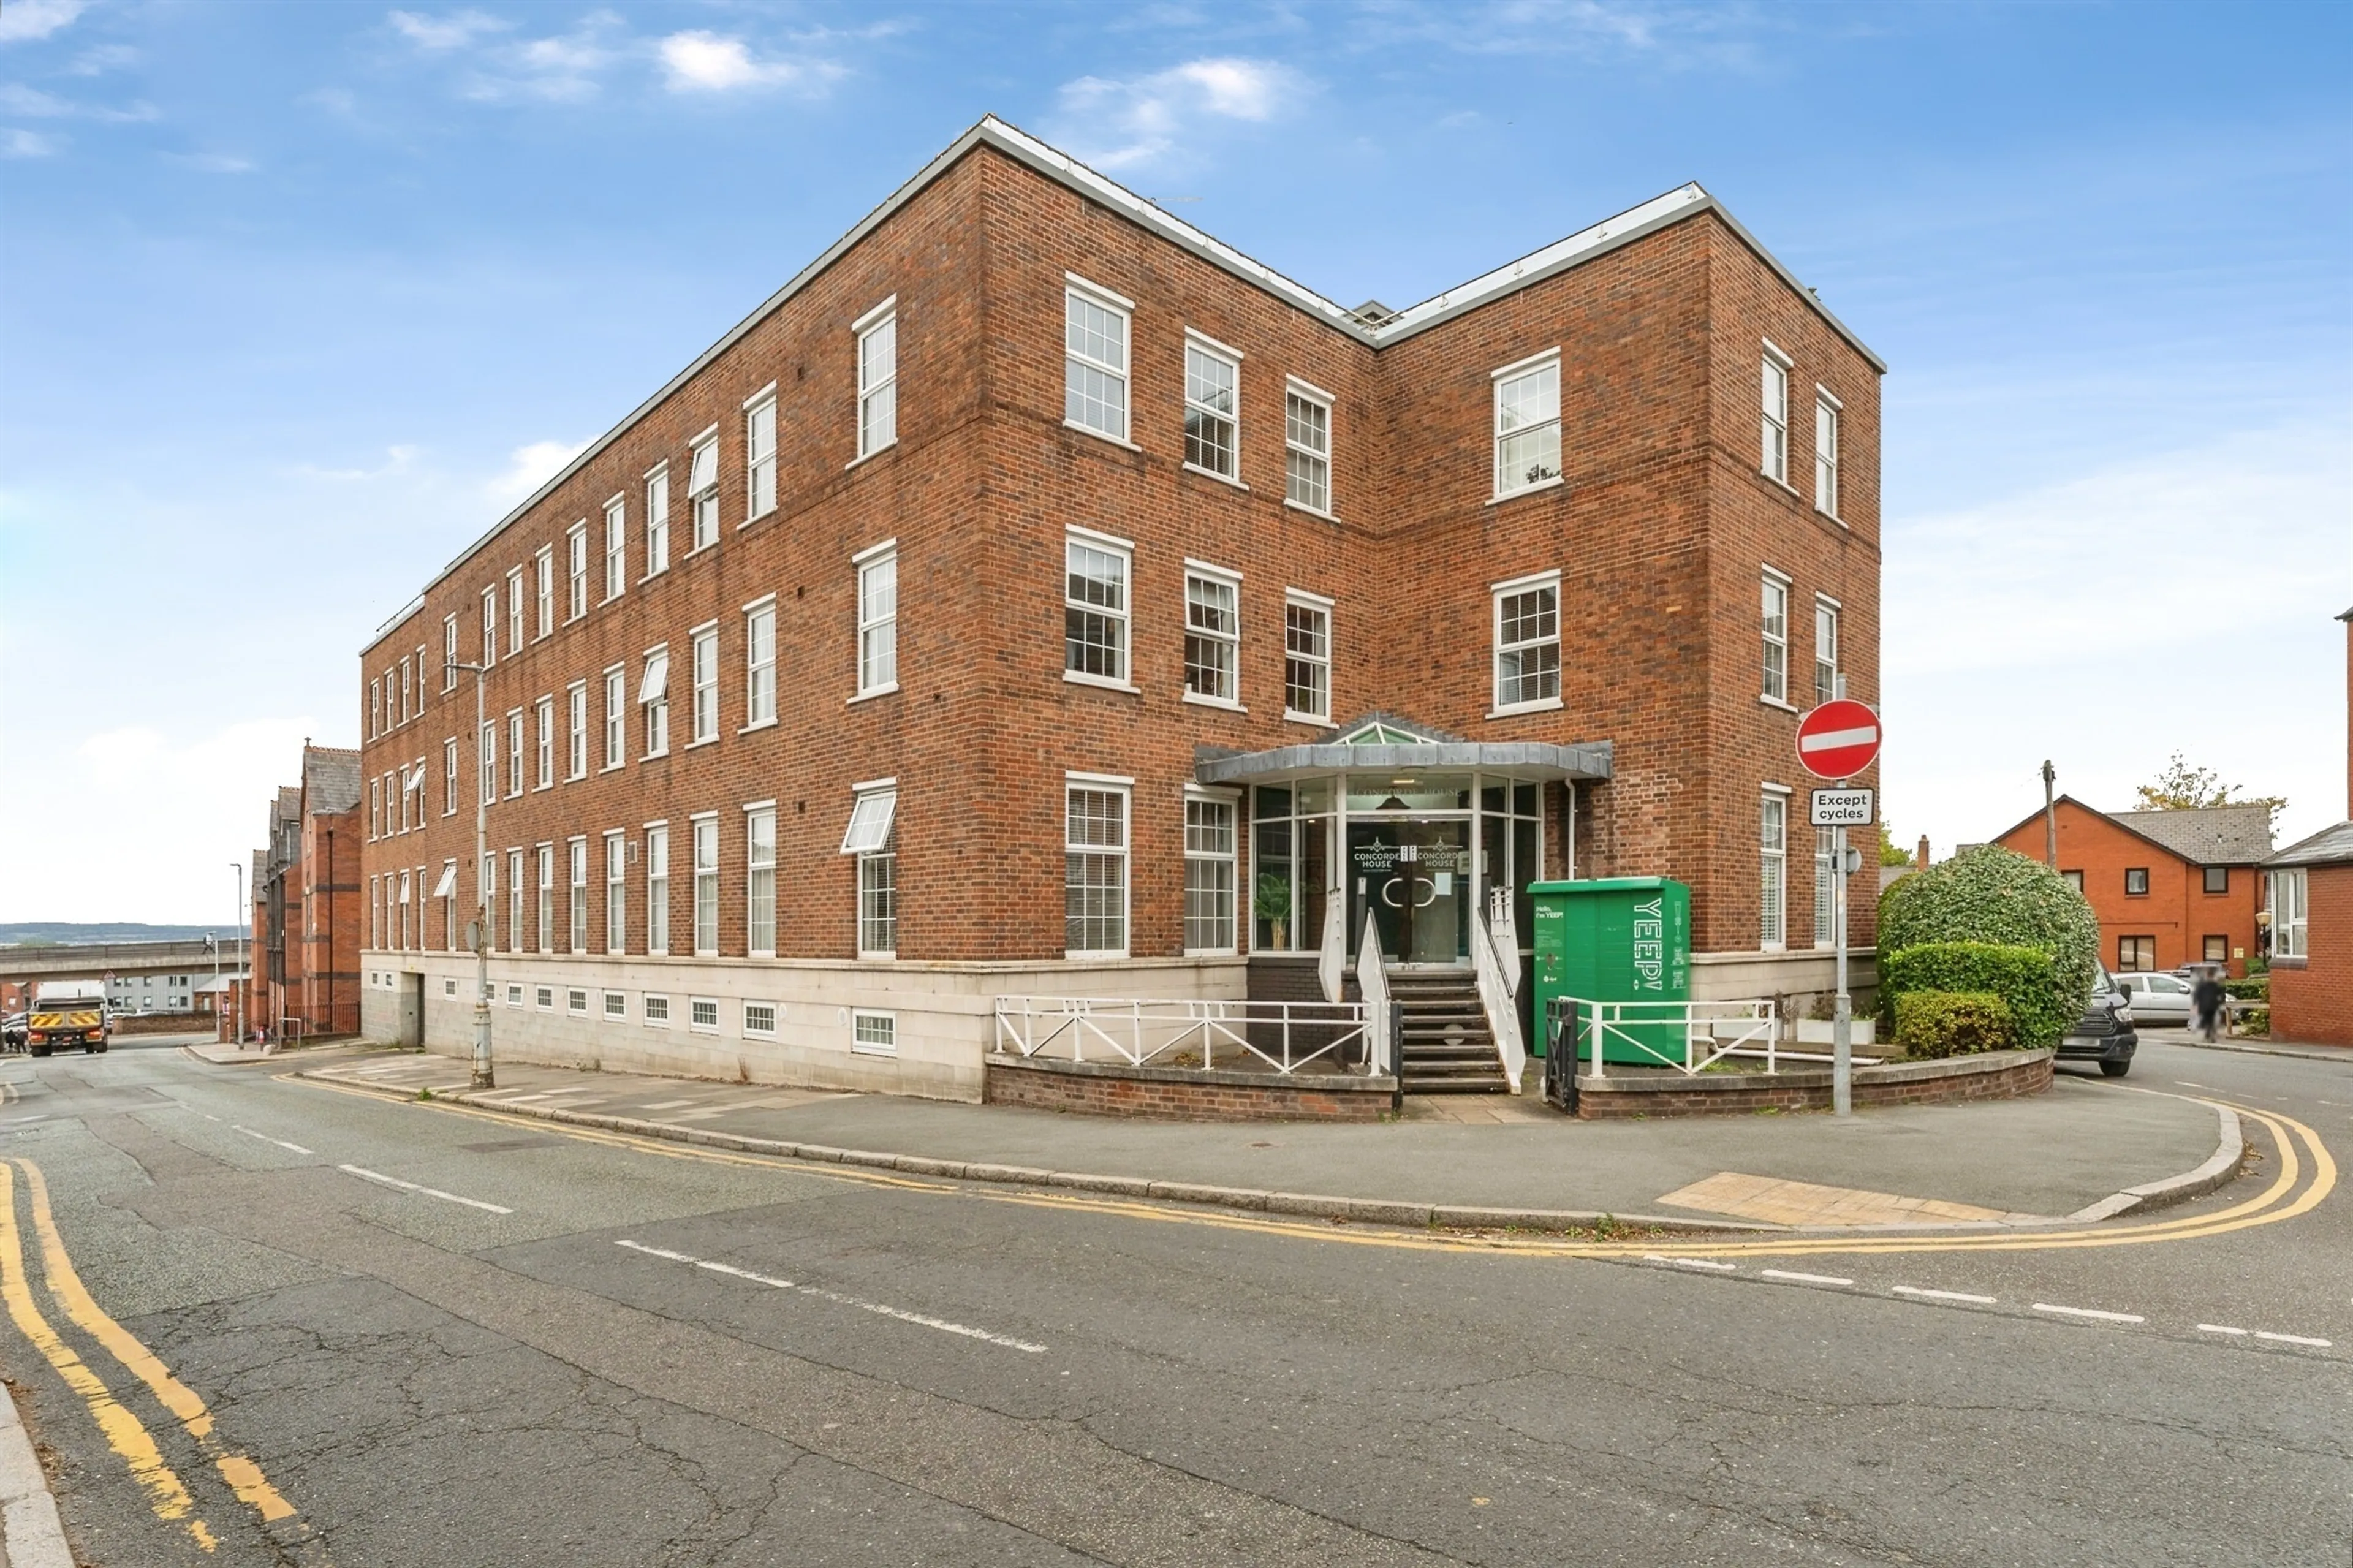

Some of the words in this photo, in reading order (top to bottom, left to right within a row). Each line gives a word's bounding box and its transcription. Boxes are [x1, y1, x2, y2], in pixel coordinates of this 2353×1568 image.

[1818, 795, 1867, 806] Except
[1819, 808, 1863, 819] cycles
[1634, 898, 1662, 991] YEEP!
